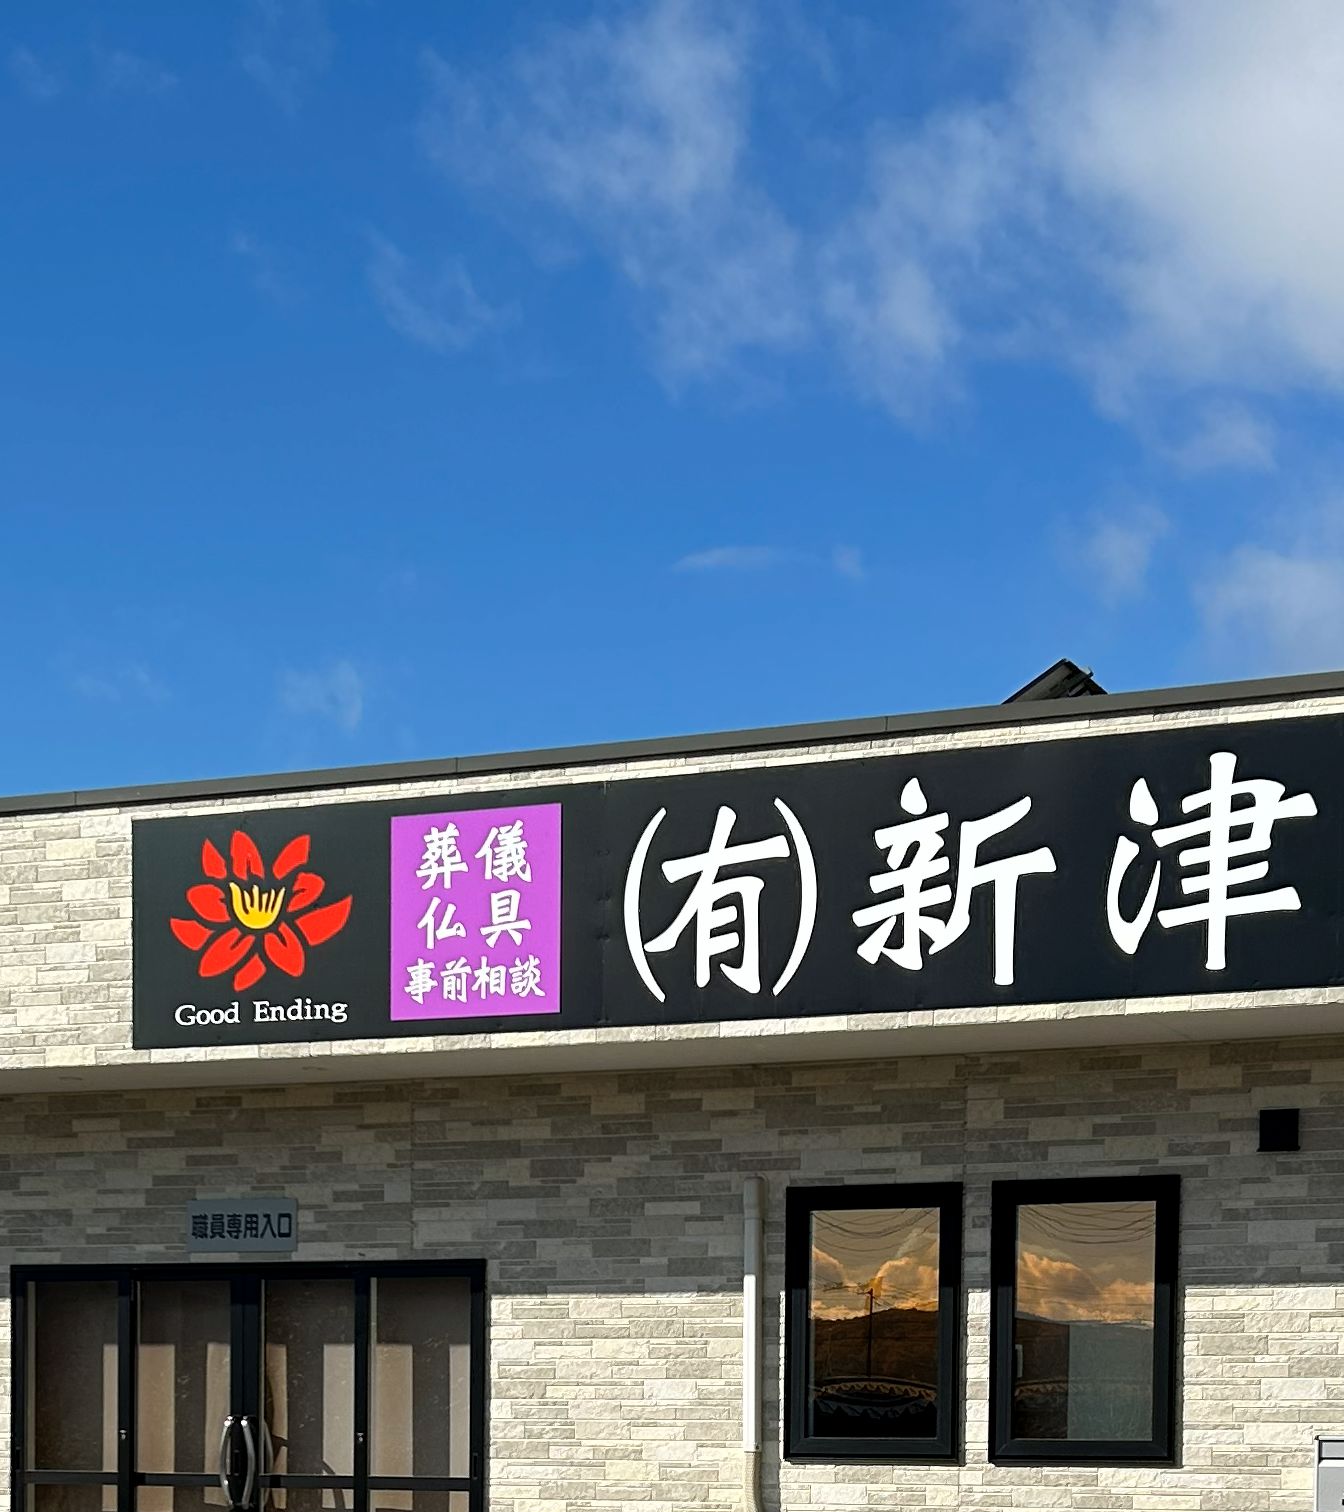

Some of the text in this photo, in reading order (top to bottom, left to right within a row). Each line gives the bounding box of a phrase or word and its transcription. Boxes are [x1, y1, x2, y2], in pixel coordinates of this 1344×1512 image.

[416, 819, 533, 890] 葬儀
[417, 889, 532, 949] 仏具
[404, 954, 546, 1005] 事前相談
[174, 999, 348, 1026] Good Ending
[191, 1213, 292, 1239] 職員専用入口
